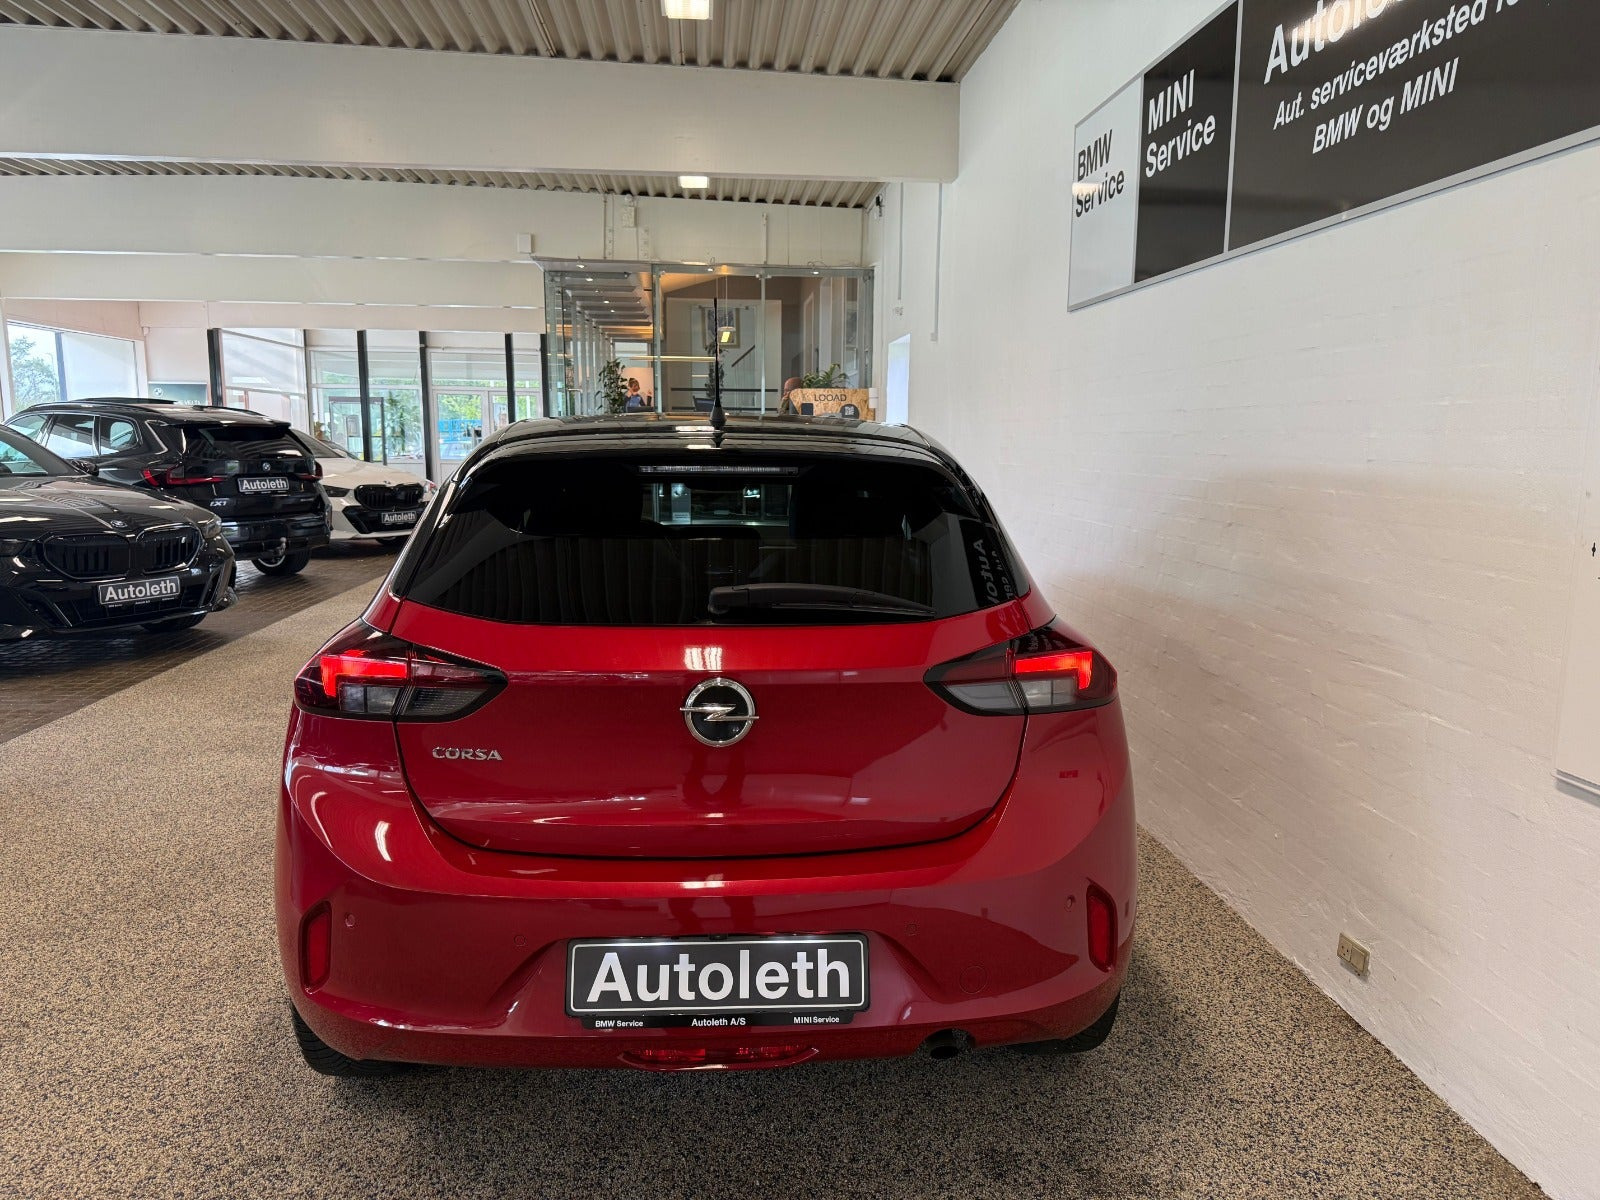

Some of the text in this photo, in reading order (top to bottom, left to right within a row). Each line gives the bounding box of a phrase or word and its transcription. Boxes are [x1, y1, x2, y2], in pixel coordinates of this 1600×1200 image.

[1273, 0, 1488, 131] Aut. serviceværksted
[1147, 68, 1195, 135] MINI
[1312, 56, 1460, 154] BMW og MINI
[1077, 128, 1113, 182] BMW
[1145, 114, 1216, 178] Service
[242, 478, 287, 490] Autoleth
[384, 512, 416, 522] Autoleth
[104, 579, 177, 602] Autoleth
[432, 746, 503, 761] CORSA
[586, 948, 850, 1003] Autoleth
[595, 1019, 644, 1028] BMW Service
[691, 1017, 747, 1027] Autoleth A/S
[793, 1015, 840, 1024] MINI Service
